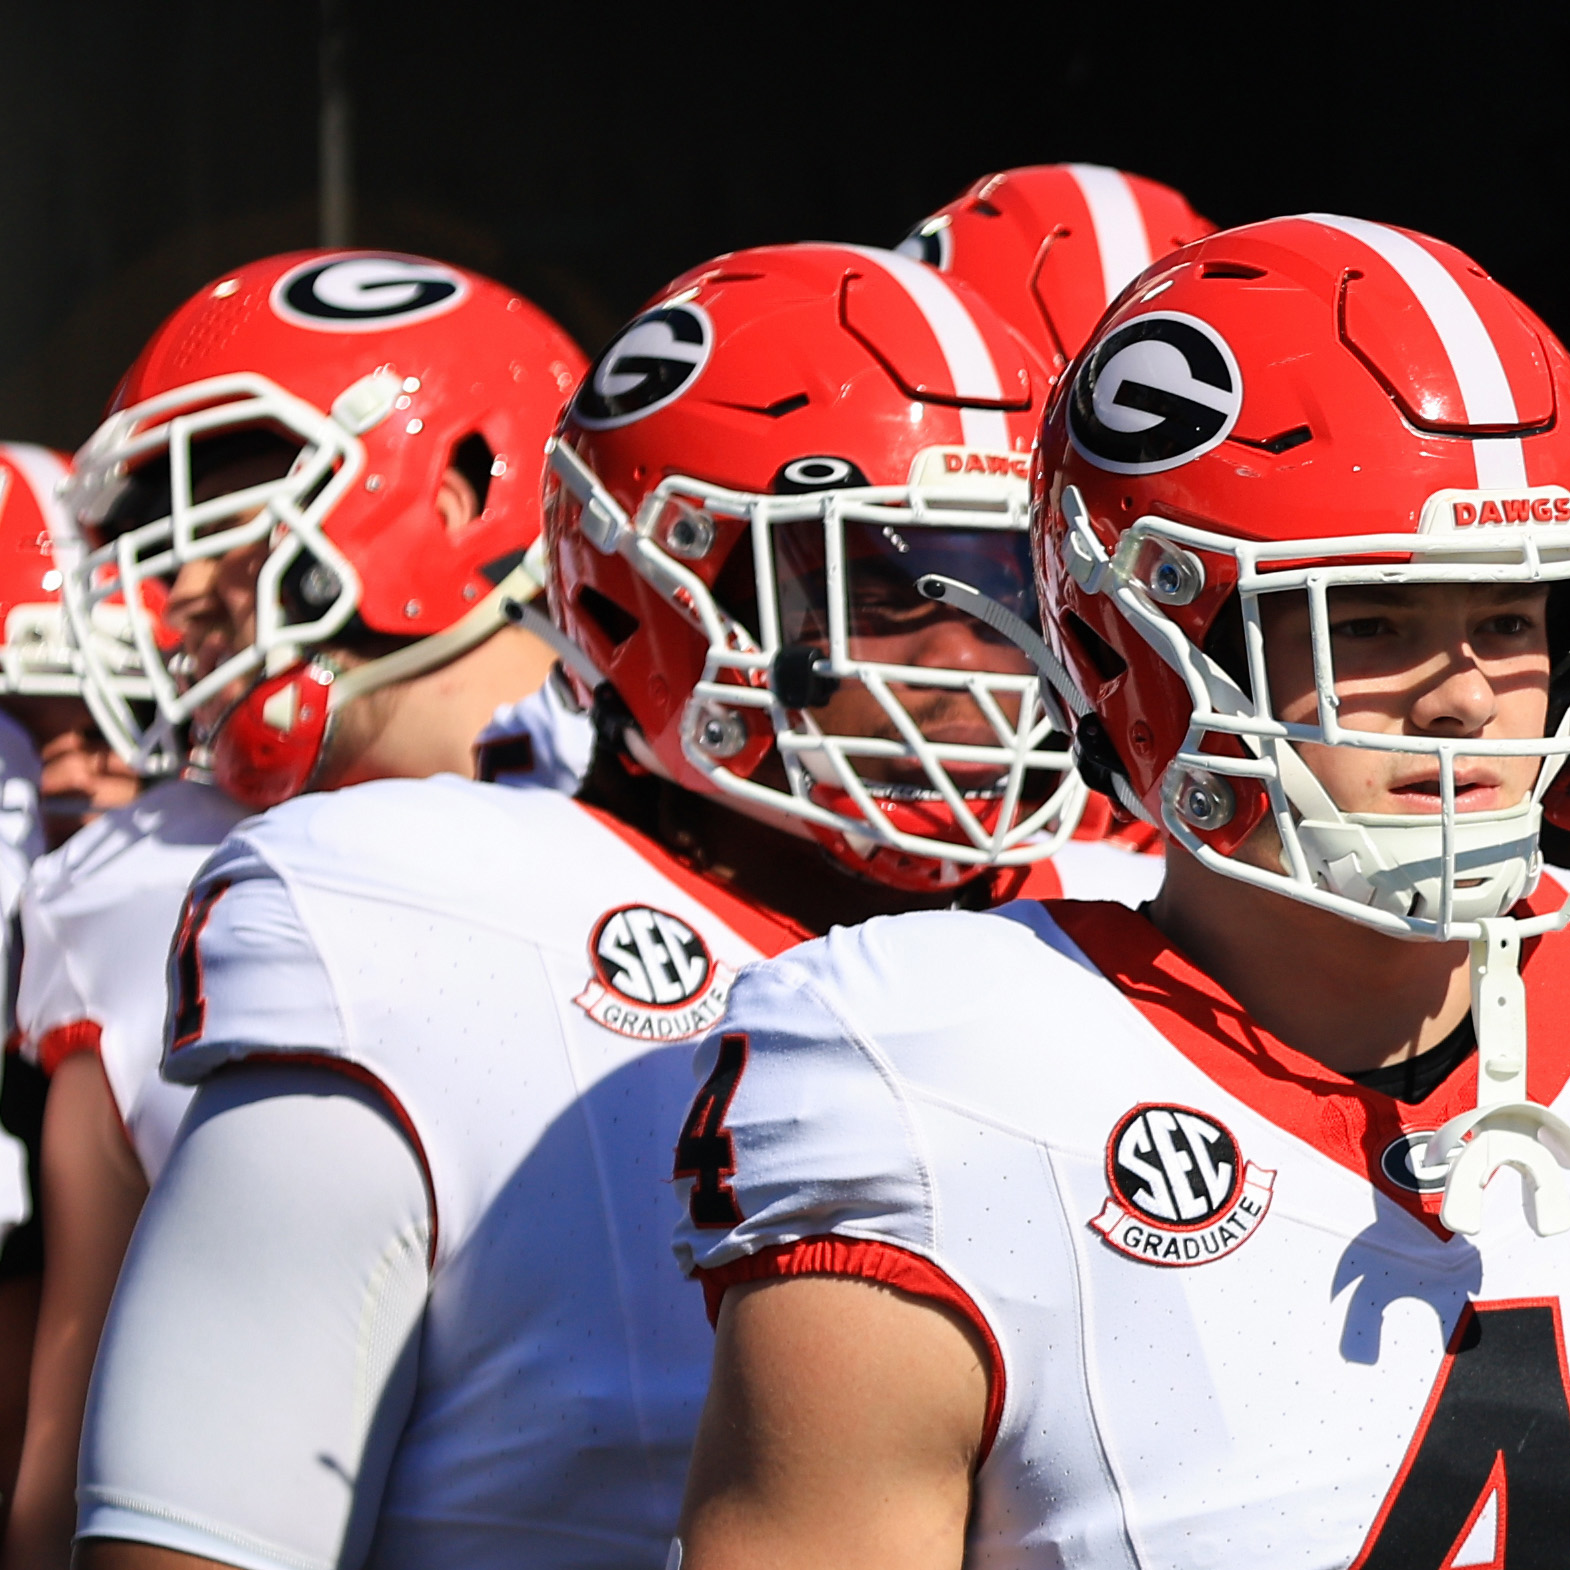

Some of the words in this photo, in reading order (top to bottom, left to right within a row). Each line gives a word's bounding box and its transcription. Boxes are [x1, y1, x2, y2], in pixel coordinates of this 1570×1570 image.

[284, 256, 457, 320] G
[573, 307, 704, 420] G
[1069, 318, 1234, 464] G
[943, 453, 1029, 479] DAWG
[597, 907, 709, 1004] SEC
[603, 988, 726, 1037] GRADUATE
[671, 1033, 750, 1230] 4
[1117, 1109, 1233, 1222] SEC
[1122, 1196, 1263, 1261] GRADUATE
